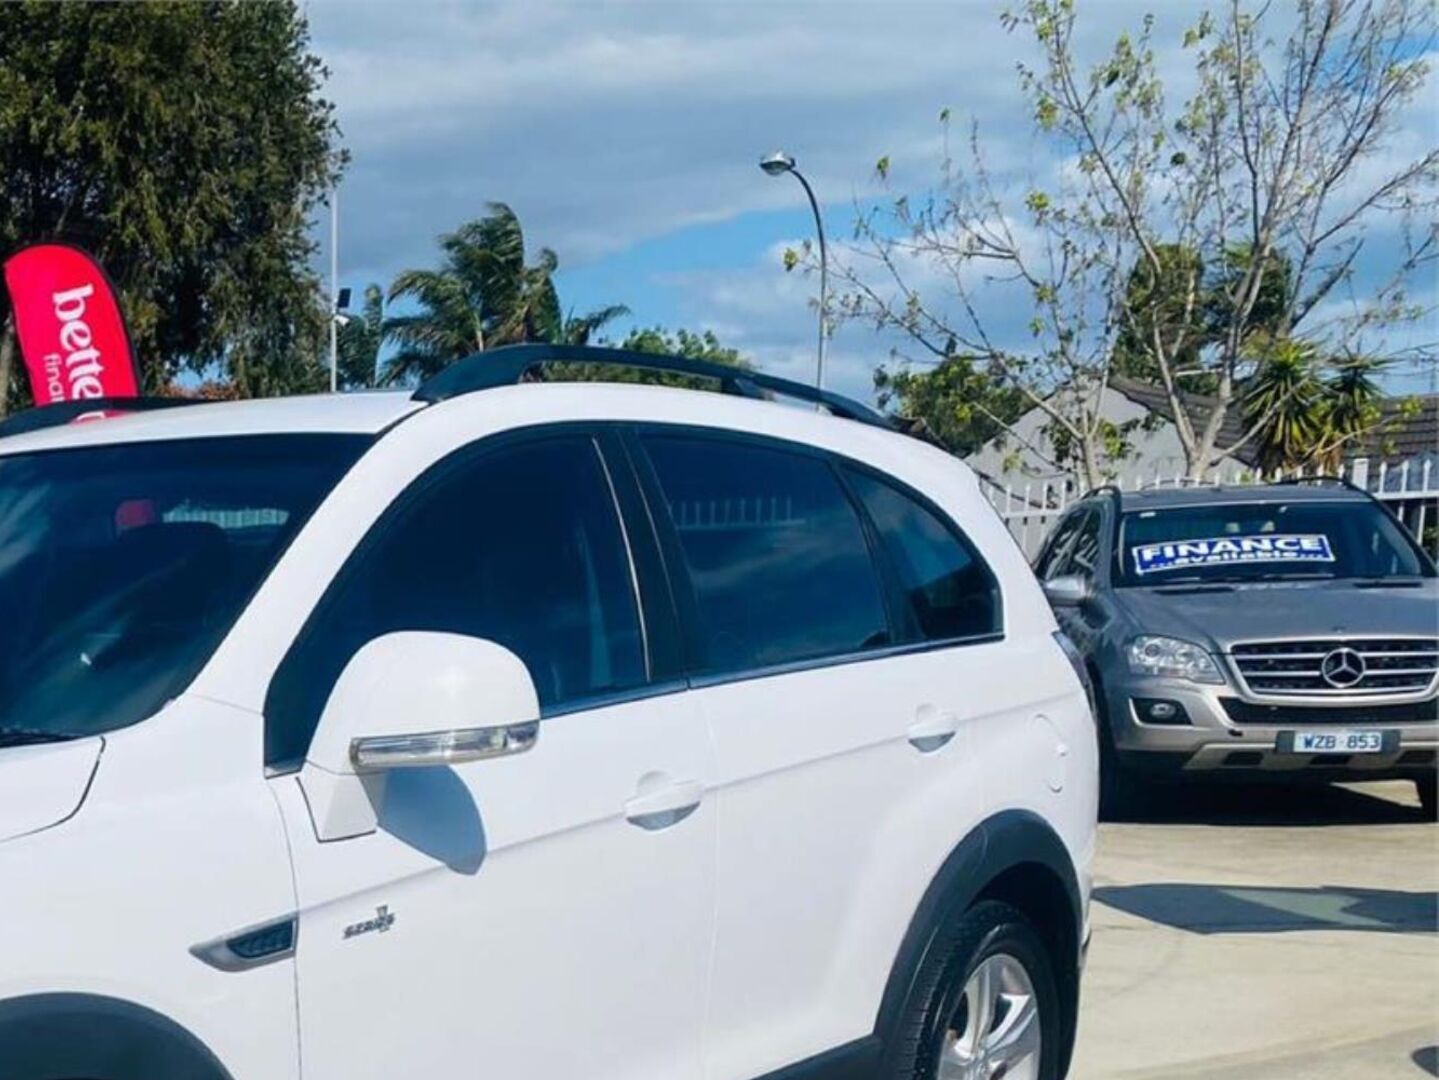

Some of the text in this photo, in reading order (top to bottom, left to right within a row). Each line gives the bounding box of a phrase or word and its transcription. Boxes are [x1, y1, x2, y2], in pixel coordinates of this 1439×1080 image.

[53, 283, 105, 420] bette
[1142, 537, 1323, 561] FINANCE
[1303, 734, 1381, 749] WZB 853
